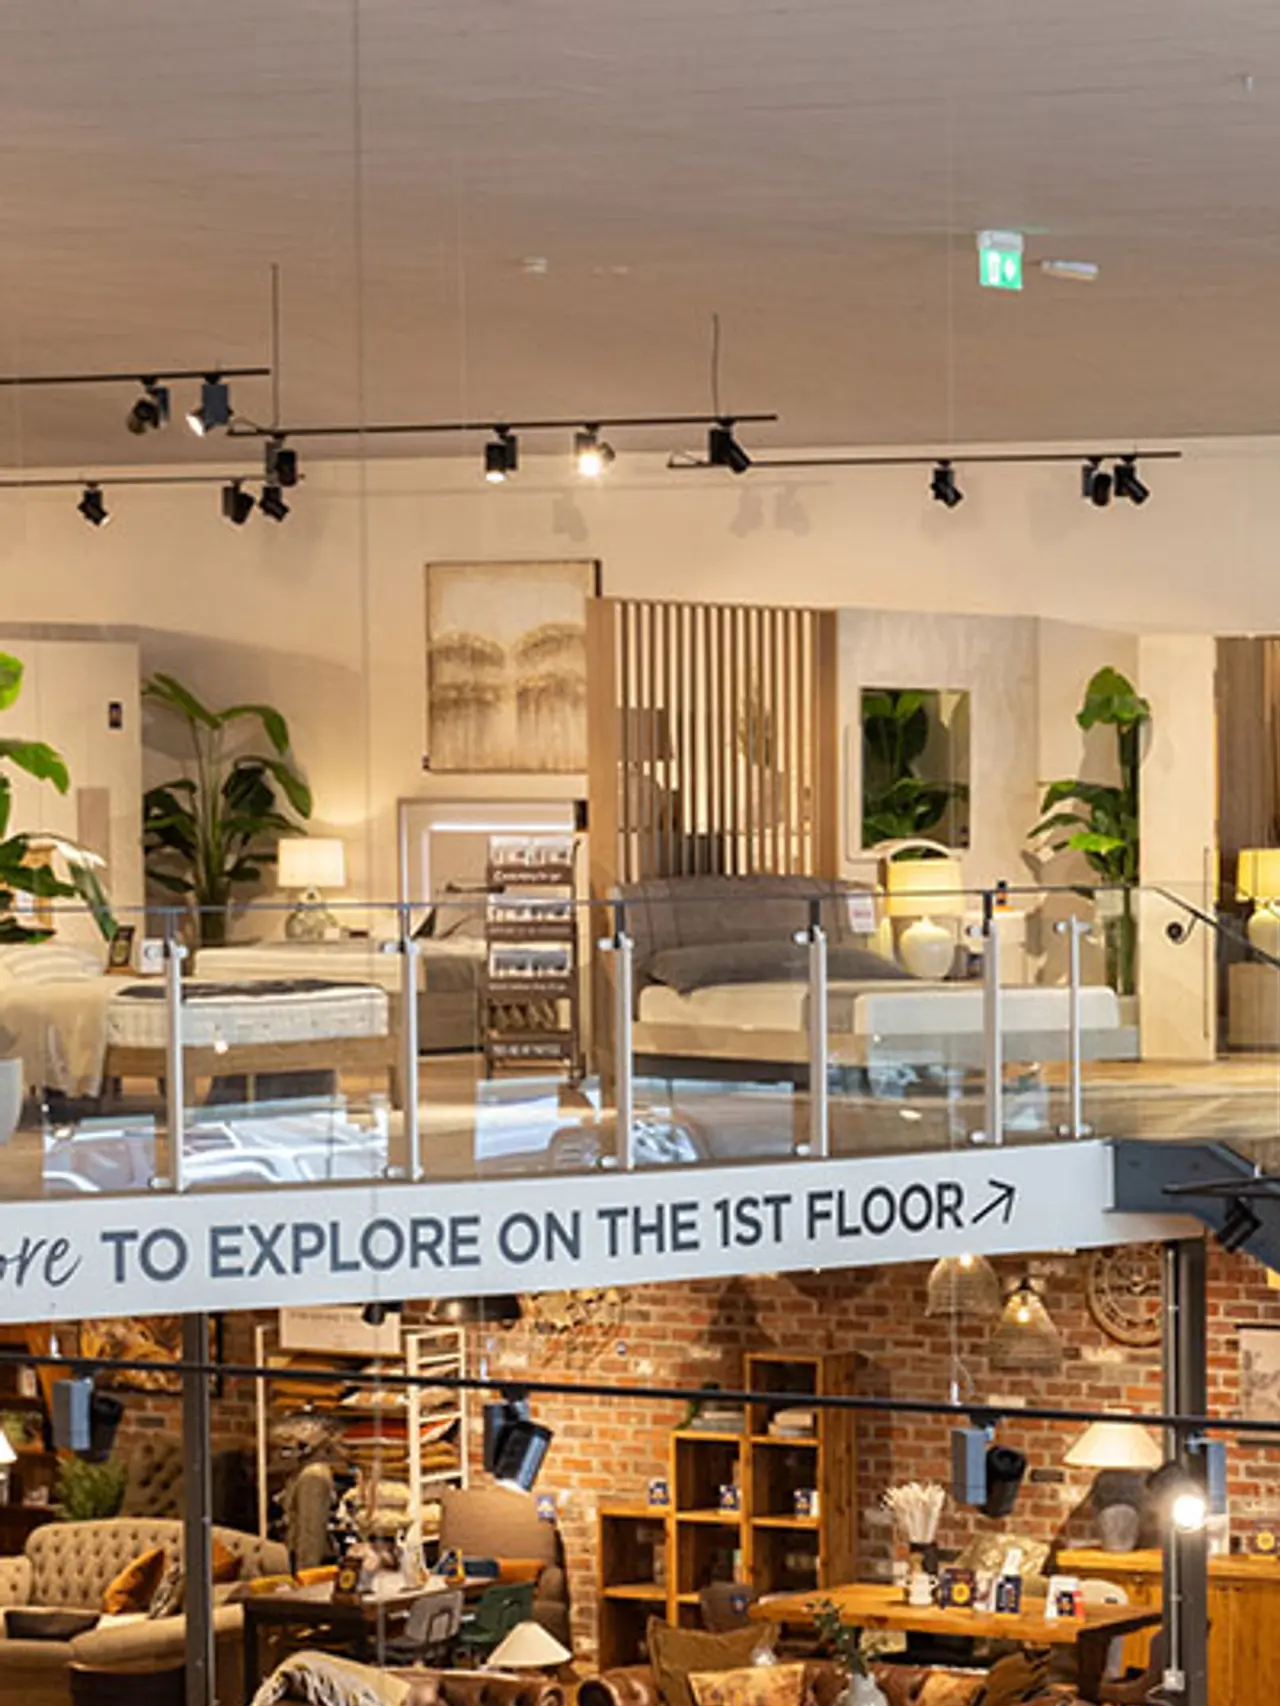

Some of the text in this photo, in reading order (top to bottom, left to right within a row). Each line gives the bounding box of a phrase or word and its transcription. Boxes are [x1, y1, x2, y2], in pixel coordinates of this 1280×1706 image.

[100, 1229, 187, 1283] TO
[210, 1215, 481, 1278] EXPLORE
[498, 1211, 580, 1264] ON
[597, 1202, 700, 1257] THE
[713, 1194, 793, 1248] 1ST
[807, 1182, 965, 1241] FLOOR
